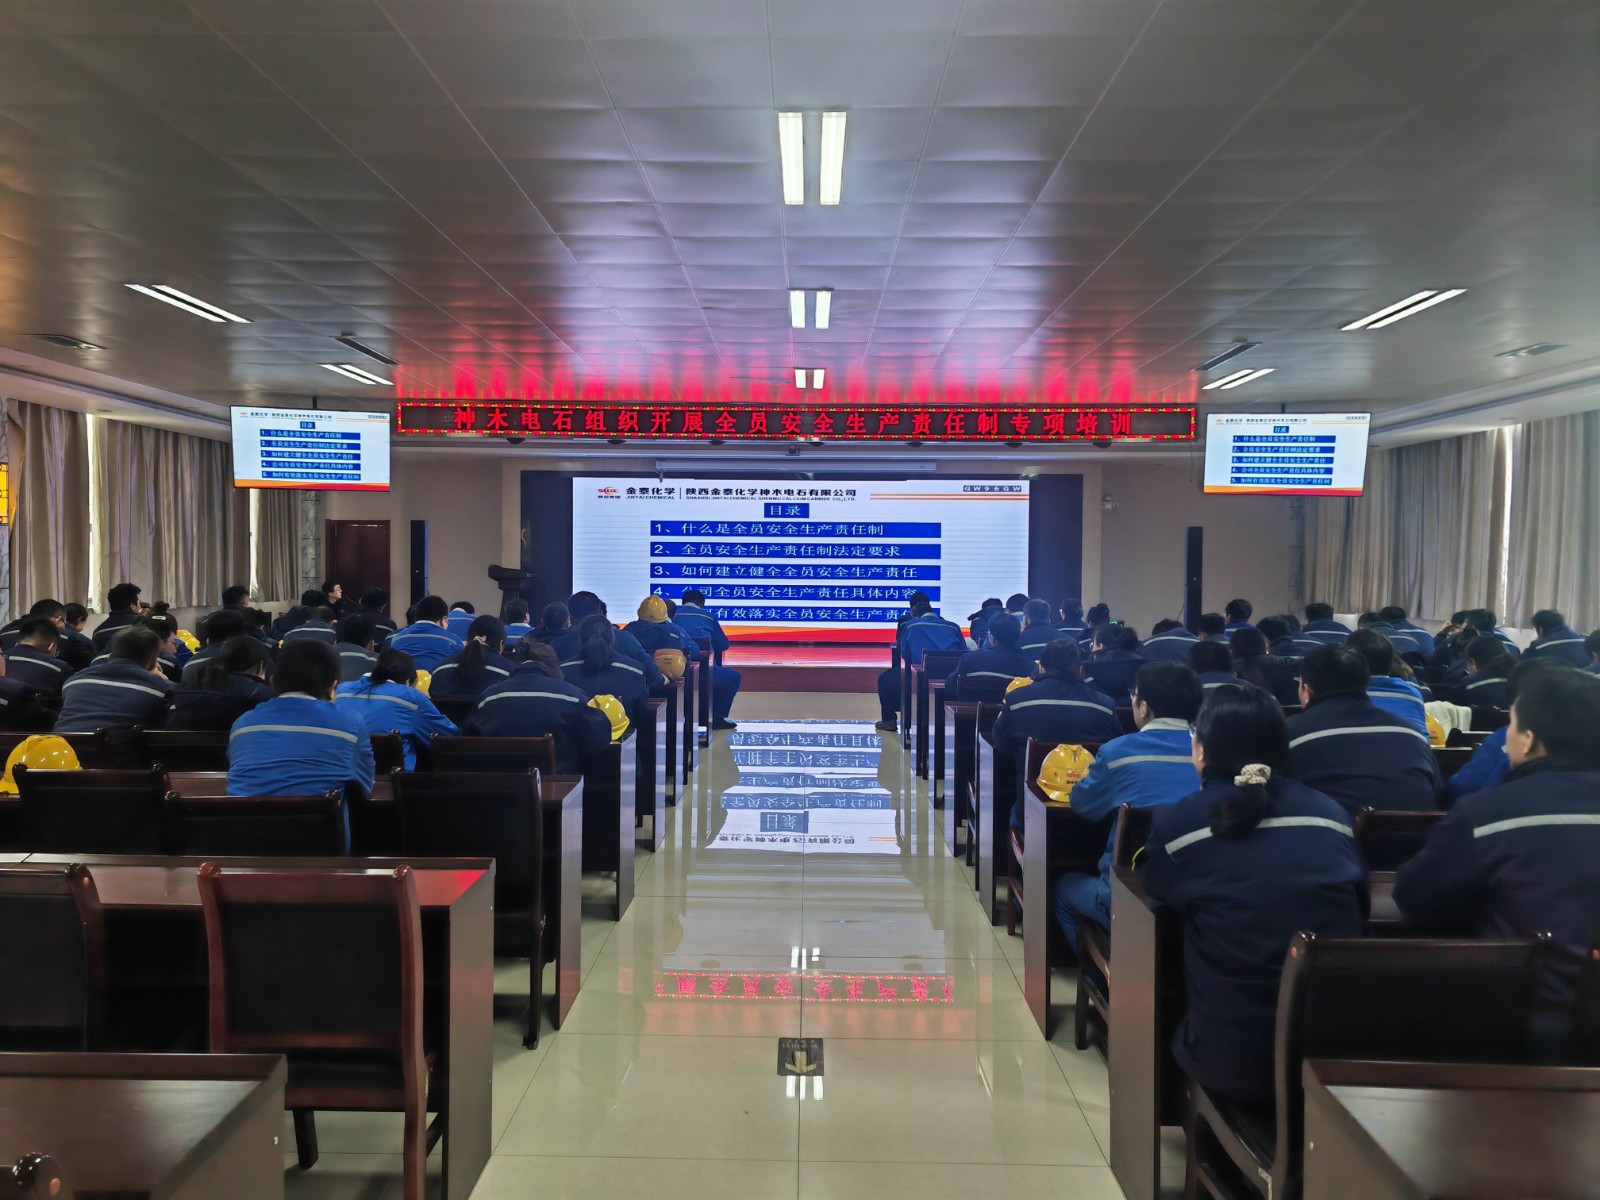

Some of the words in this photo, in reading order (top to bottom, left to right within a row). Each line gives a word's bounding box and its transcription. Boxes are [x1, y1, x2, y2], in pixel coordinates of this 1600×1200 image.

[454, 407, 1132, 435] 神木电石组织开展全员安全生产责任制专项培训
[626, 487, 675, 495] 金泰化学
[686, 487, 857, 497] 陕西金泰化学神木电石有限公司
[769, 505, 802, 516] 目录
[655, 522, 884, 536] 1、什么是全员安全生产责任制
[654, 543, 901, 557] 2、全员安全生产责任制法定要求
[654, 565, 918, 578] 3、如何建立健全全员安全生产责任
